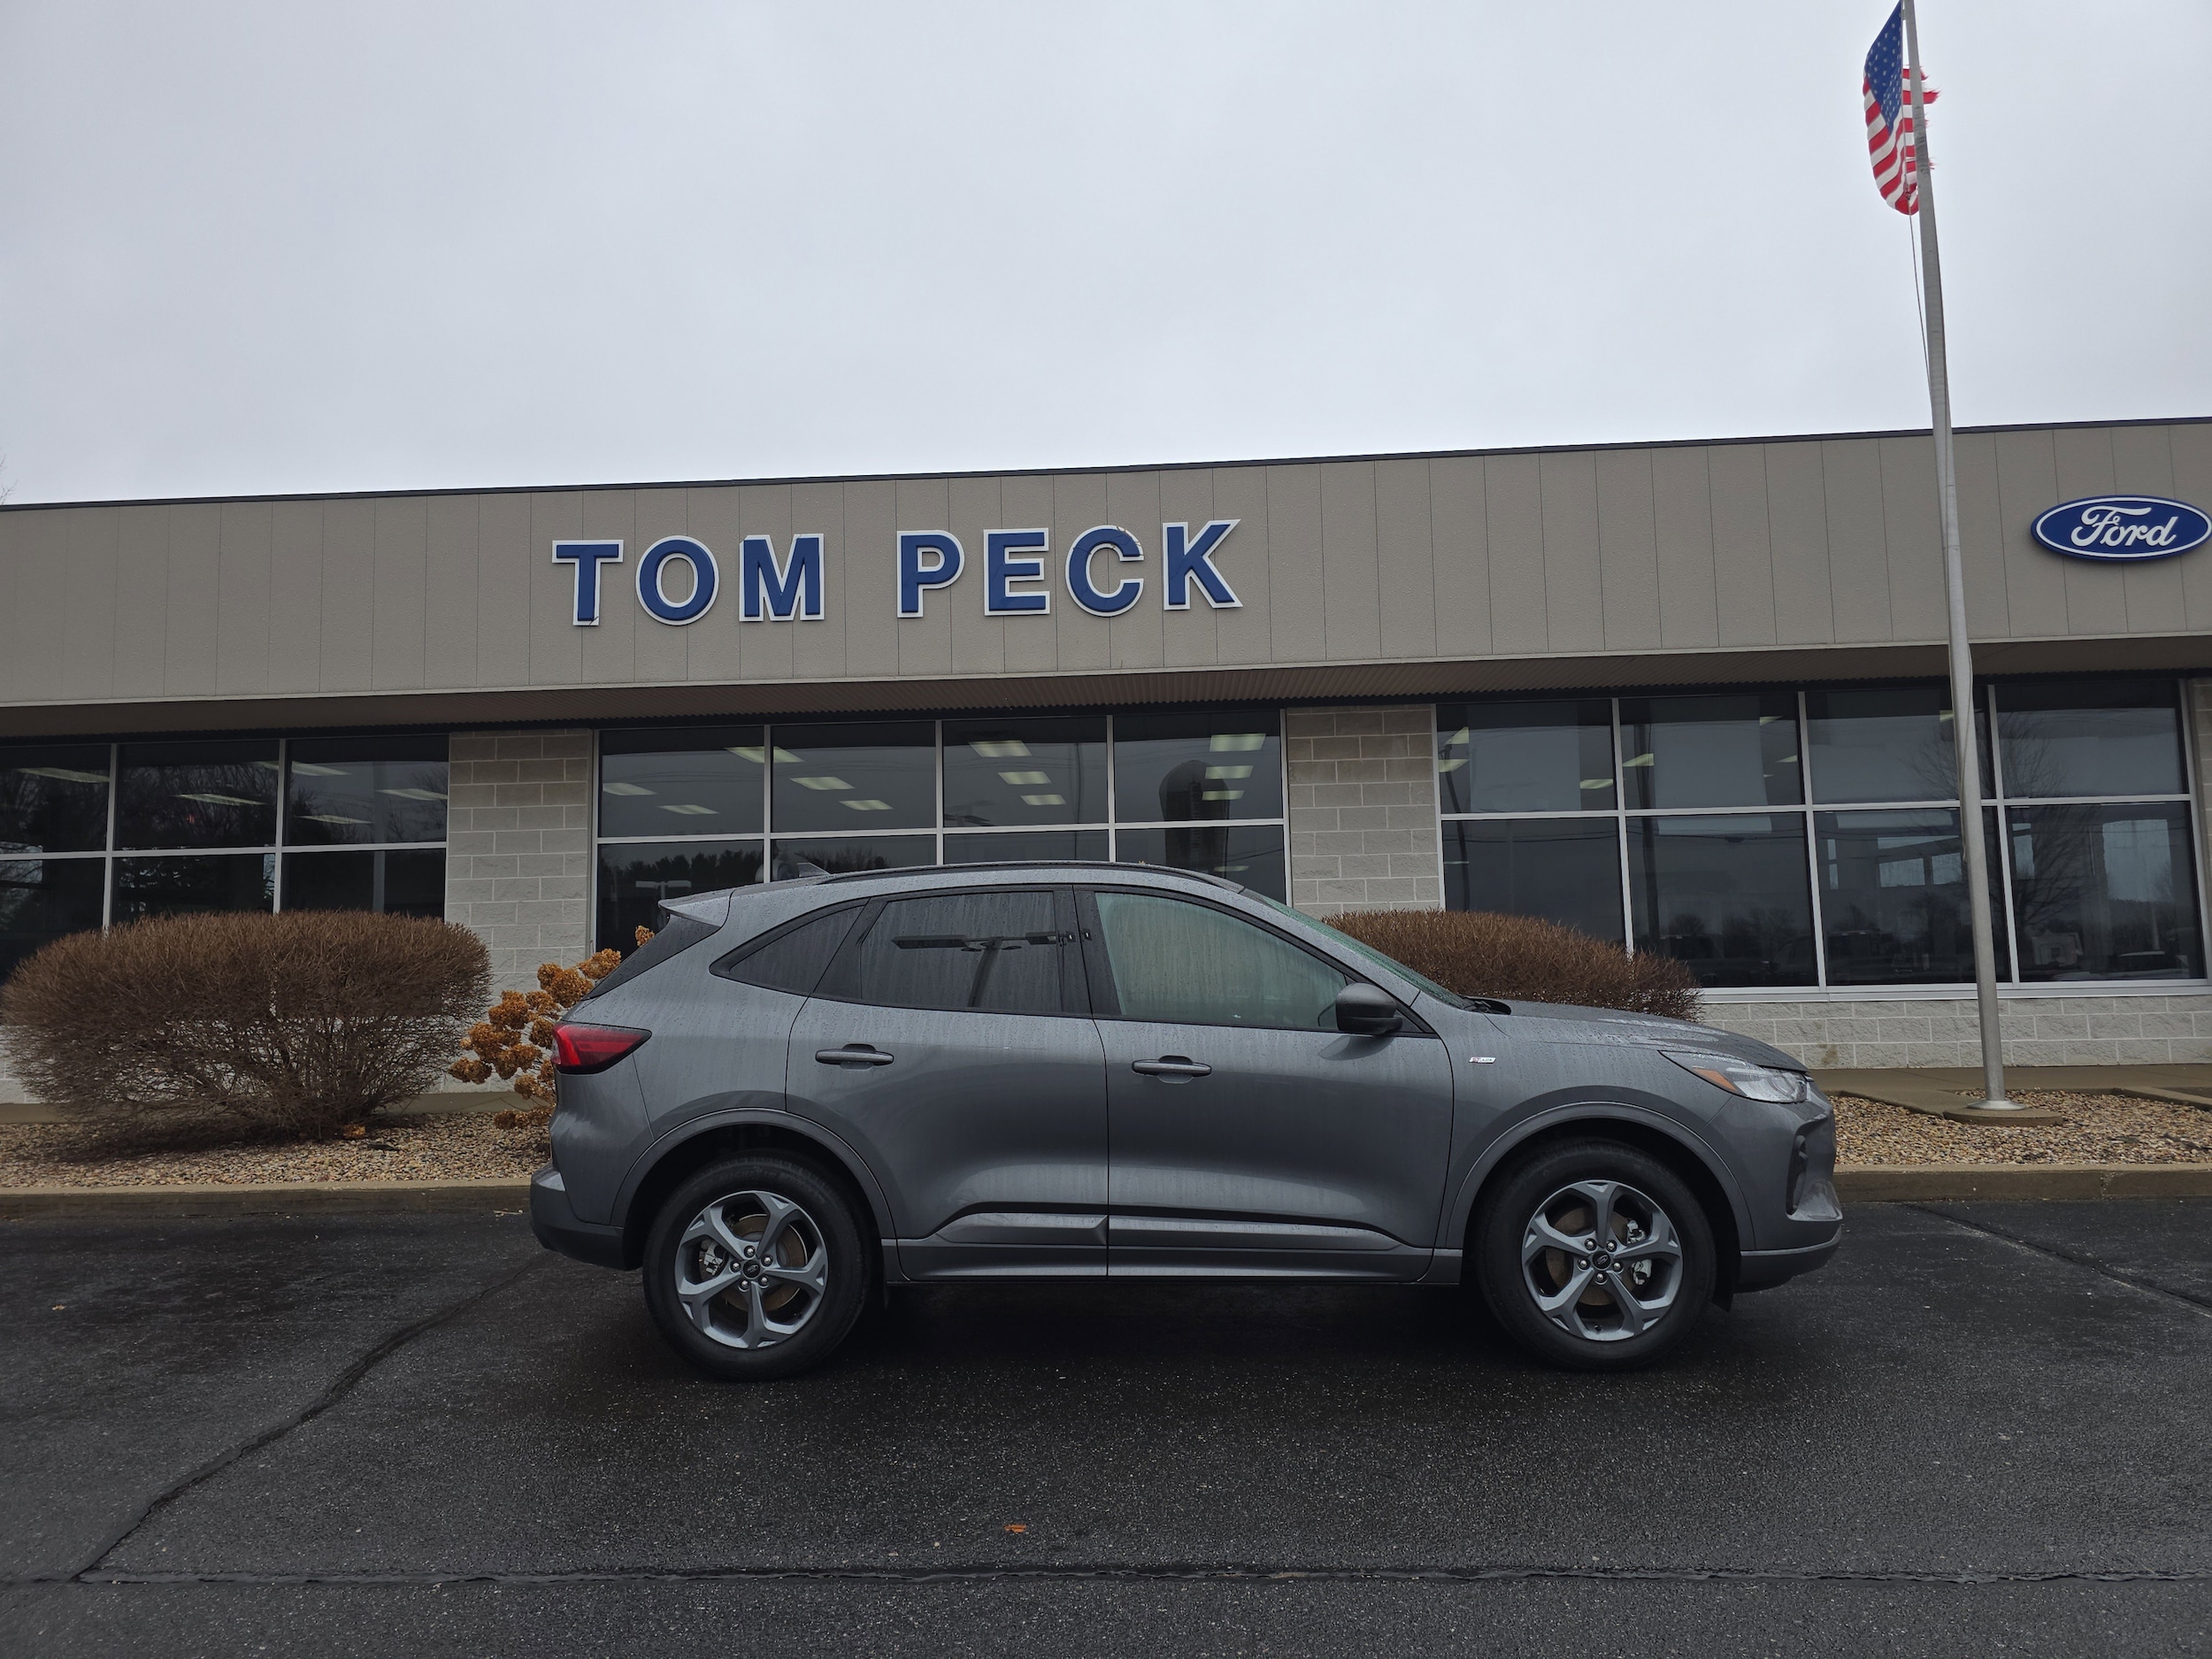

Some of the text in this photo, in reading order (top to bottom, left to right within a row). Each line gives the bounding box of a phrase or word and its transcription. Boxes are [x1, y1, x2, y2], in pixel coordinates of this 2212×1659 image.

[2070, 505, 2179, 547] Ford
[552, 518, 1243, 626] TOM PECK
